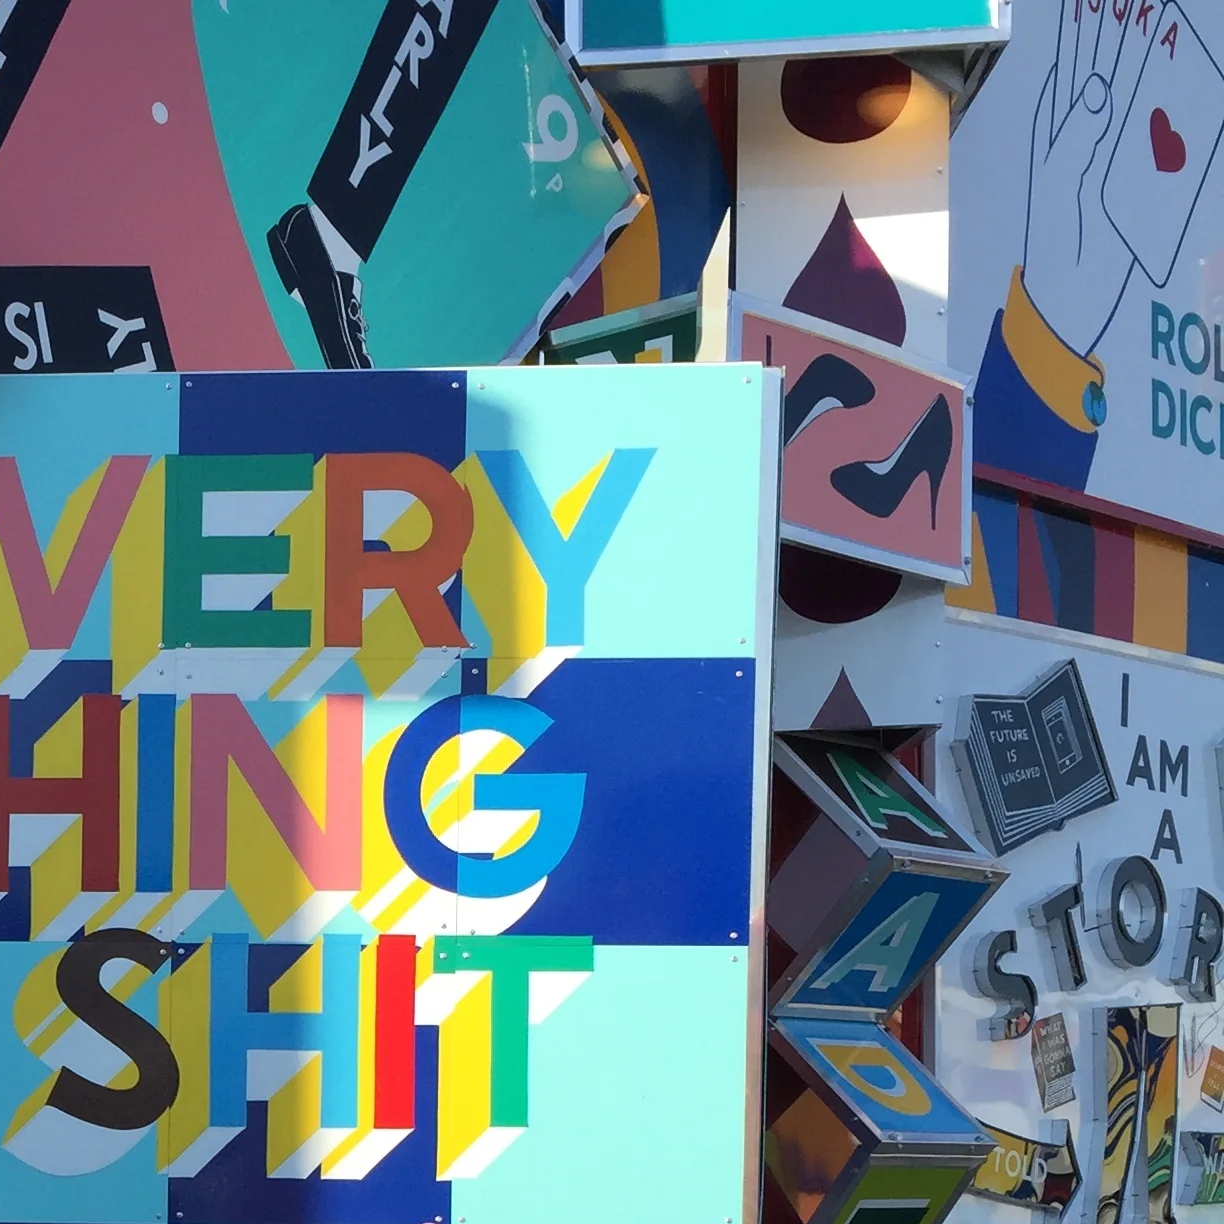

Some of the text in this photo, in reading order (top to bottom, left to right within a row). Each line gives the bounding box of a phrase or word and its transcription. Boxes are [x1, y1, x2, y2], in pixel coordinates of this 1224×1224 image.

[1150, 377, 1224, 460] DIC
[990, 709, 1014, 724] THE
[989, 728, 1030, 744] FUTURE
[1006, 748, 1018, 763] IS
[1126, 734, 1189, 797] AM
[1000, 766, 1041, 786] UNSAVED
[1150, 809, 1183, 864] A
[46, 926, 596, 1131] SHIT
[992, 1147, 1049, 1184] TOLD
